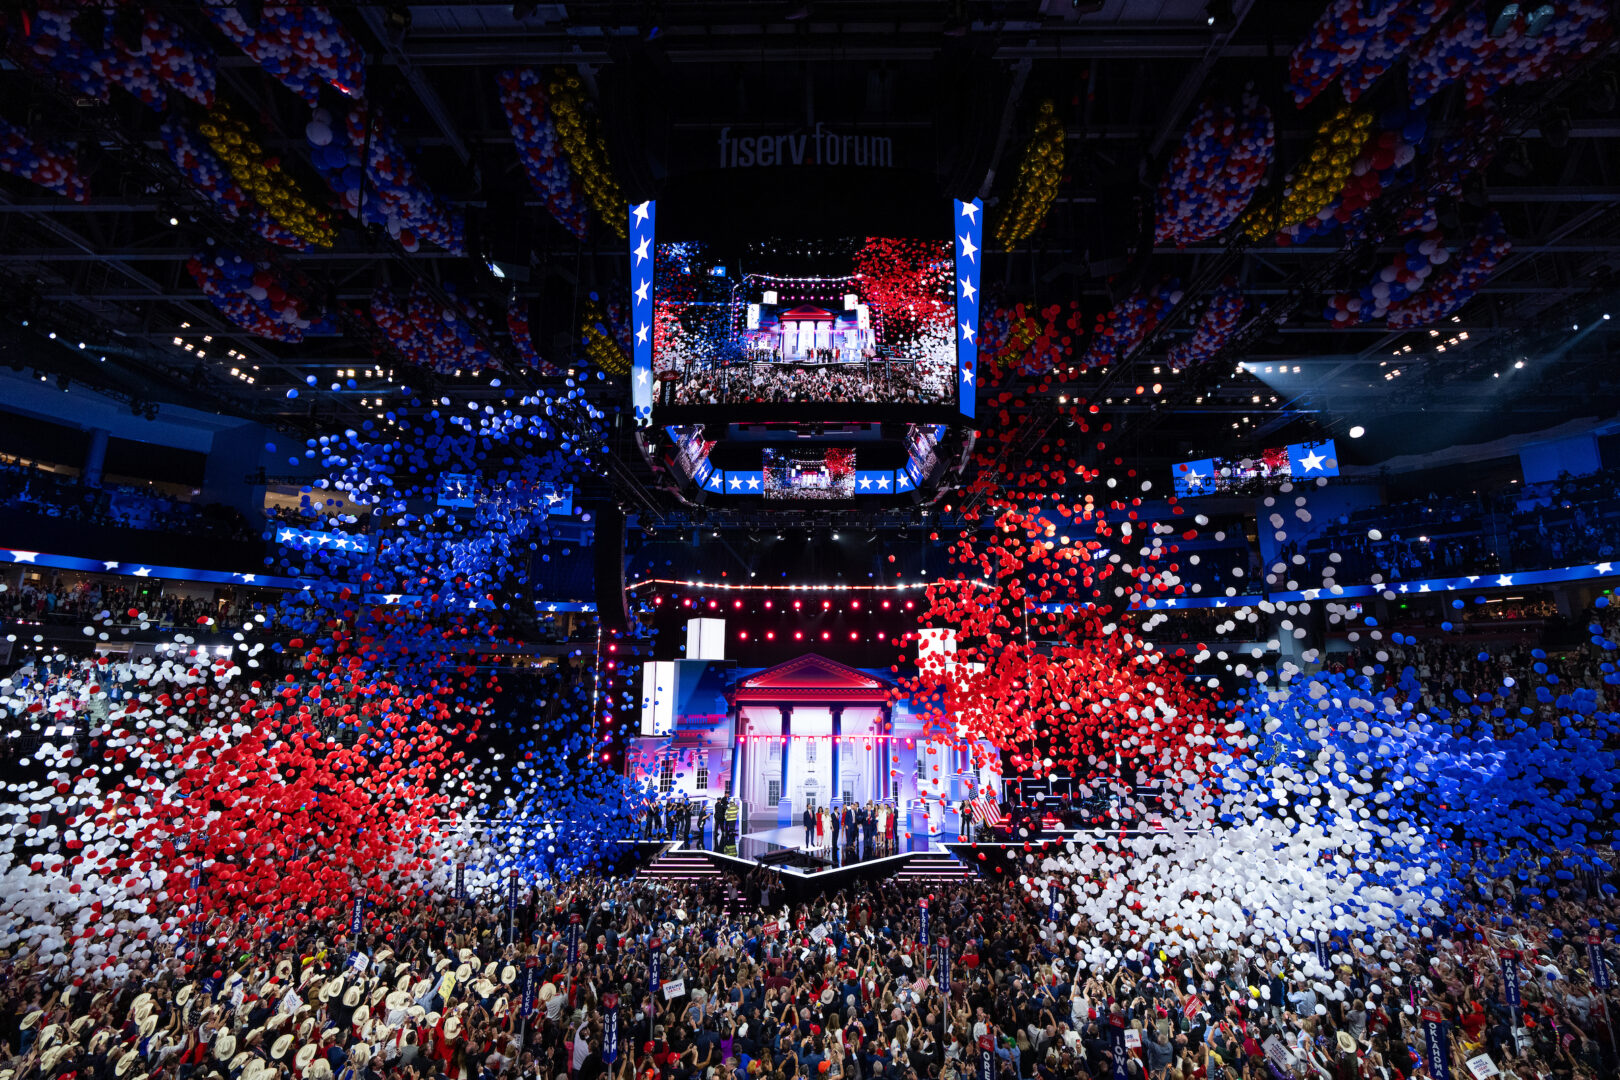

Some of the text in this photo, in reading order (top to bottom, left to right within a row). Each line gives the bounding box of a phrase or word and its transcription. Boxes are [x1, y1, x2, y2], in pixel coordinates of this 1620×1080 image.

[812, 122, 893, 167] forum
[354, 899, 362, 930] TEXAS
[666, 982, 683, 991] TRUMP
[1505, 959, 1515, 1002] HAWAII
[1593, 945, 1607, 986] MICHIGAN
[525, 968, 534, 1013] KENTUCKY
[1114, 1035, 1126, 1076] IOWA
[1429, 1022, 1444, 1078] OKLAHOMA
